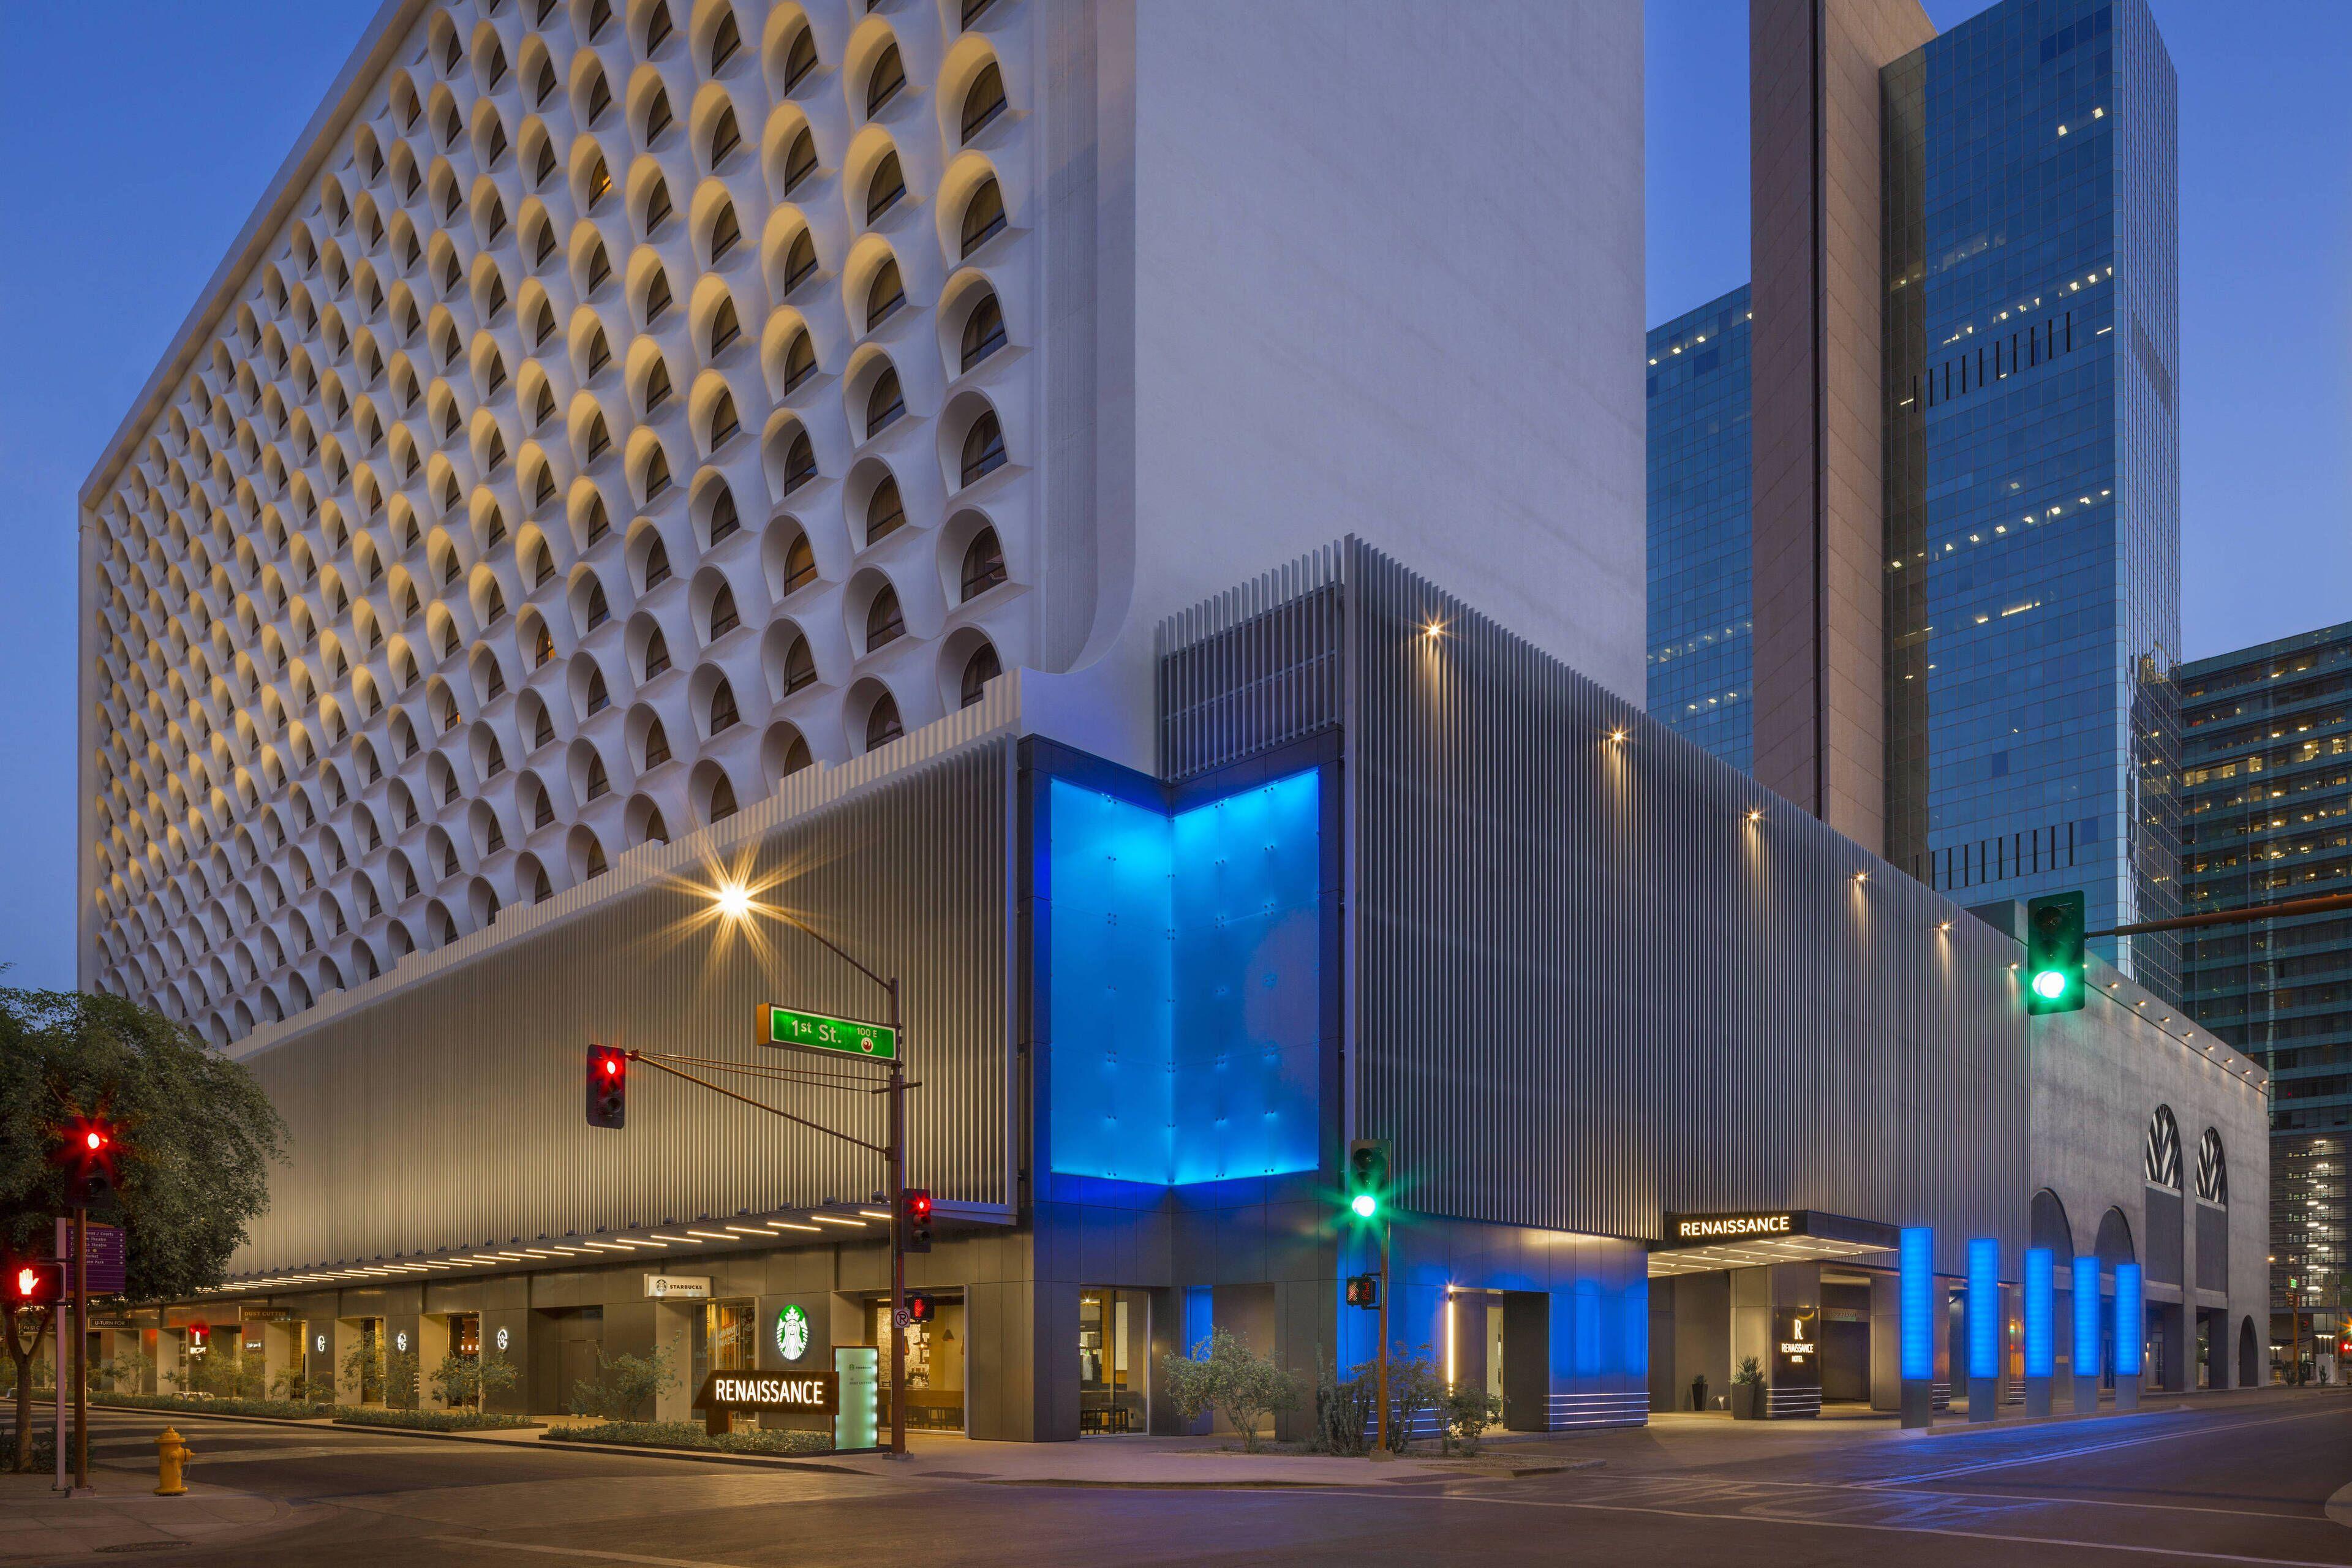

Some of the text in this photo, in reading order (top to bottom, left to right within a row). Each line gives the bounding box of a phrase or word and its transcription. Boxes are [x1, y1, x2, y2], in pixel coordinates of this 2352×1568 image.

[792, 1020, 842, 1044] 1st St.
[858, 1027, 878, 1038] 100 E
[1681, 1216, 1790, 1236] RENAISSANCE
[1794, 1319, 1804, 1340] R
[1782, 1343, 1814, 1353] RENAISSANCE
[716, 1380, 823, 1404] RENAISSANCE
